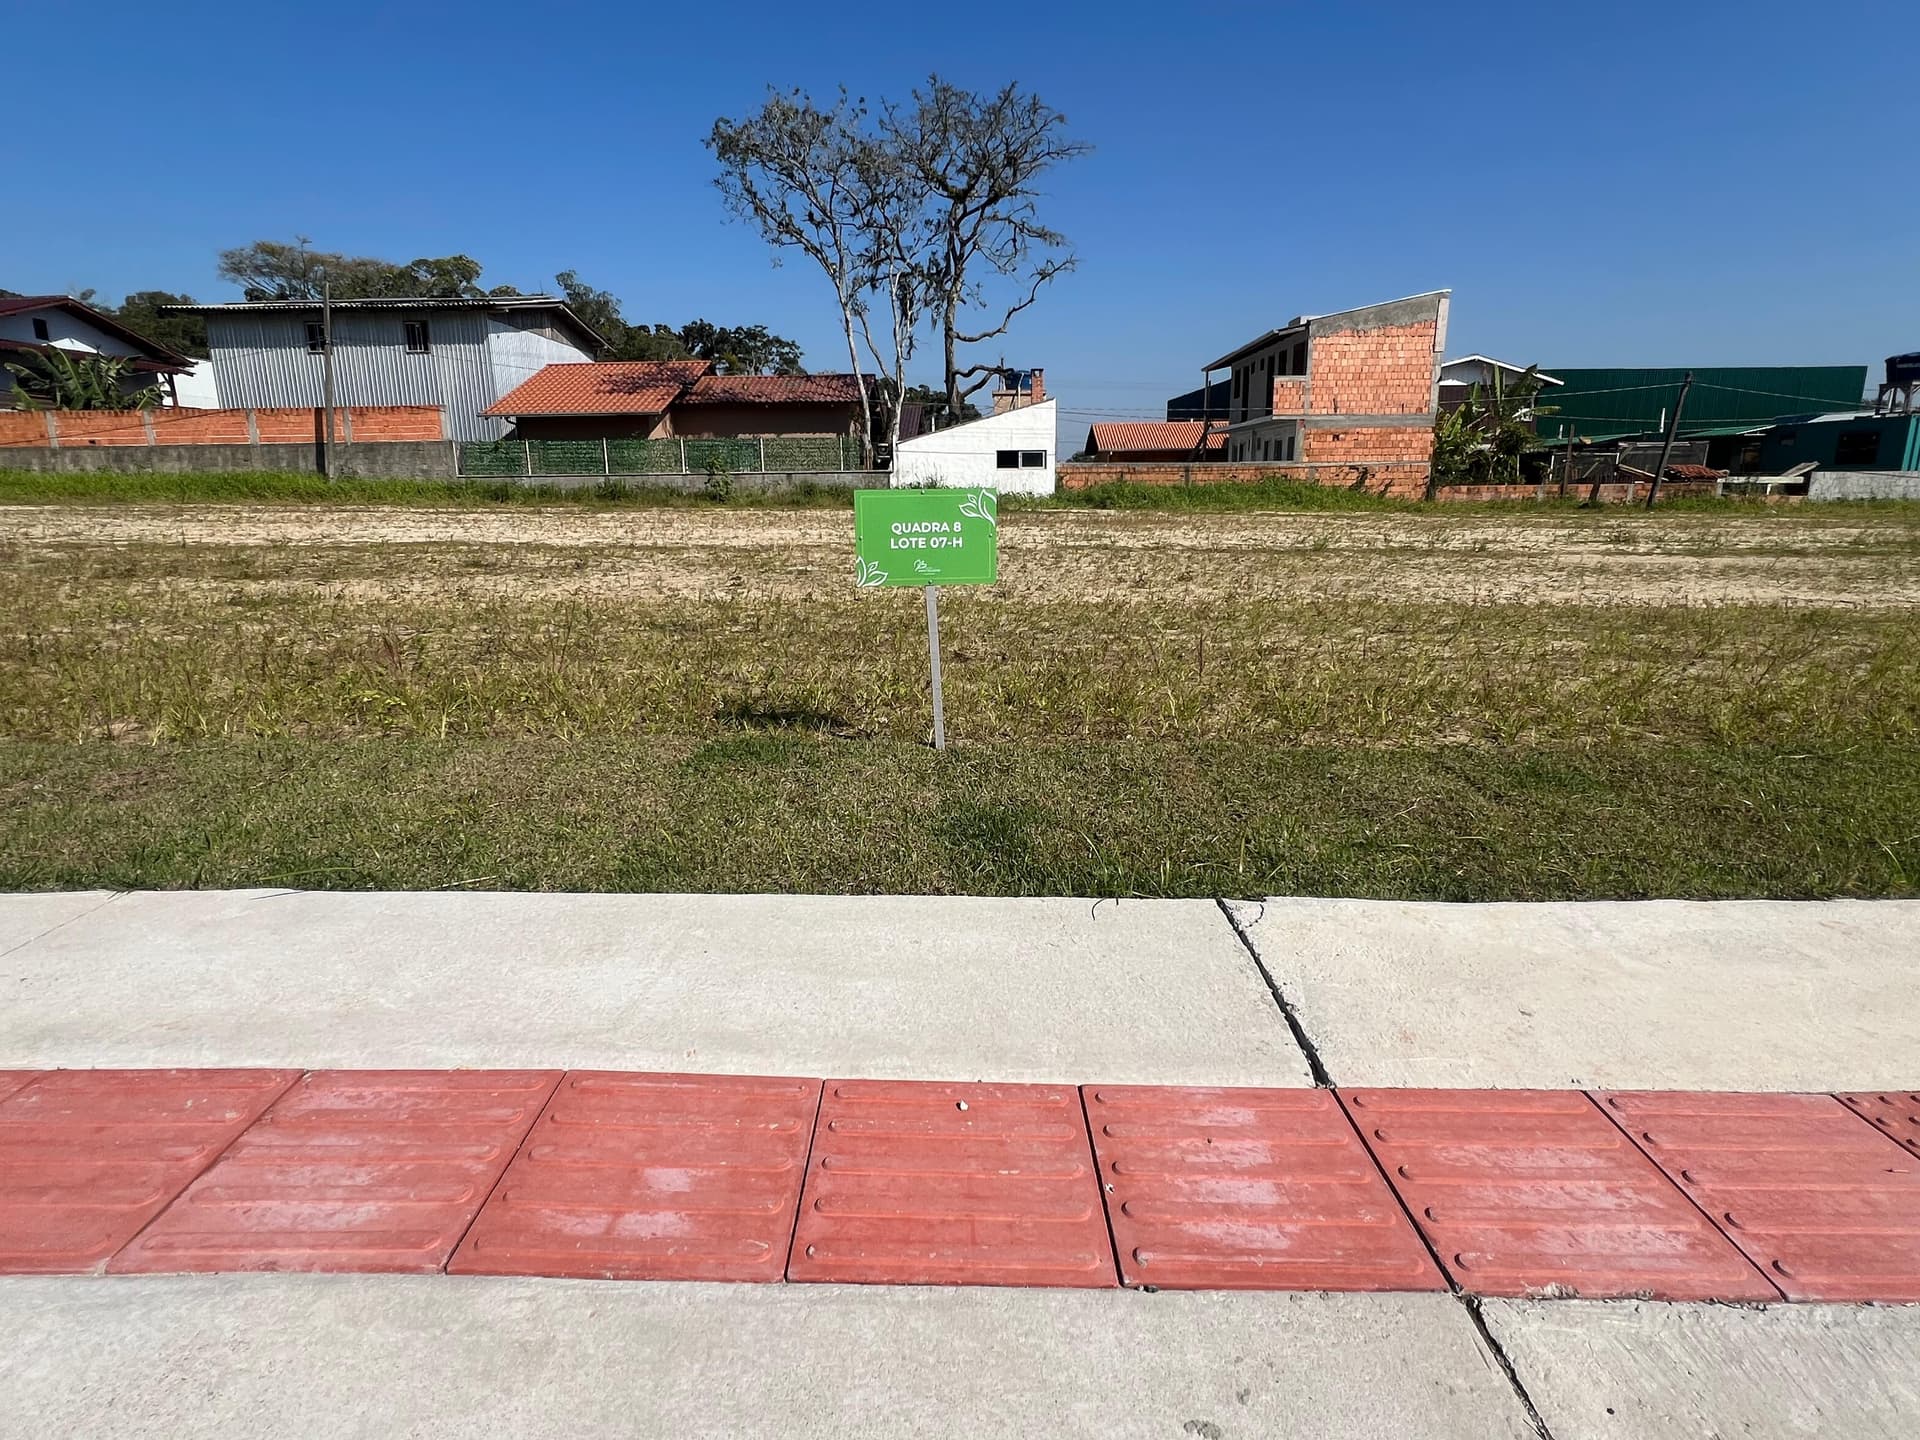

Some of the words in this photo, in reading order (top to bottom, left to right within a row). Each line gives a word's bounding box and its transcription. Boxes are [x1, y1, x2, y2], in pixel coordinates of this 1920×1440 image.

[891, 522, 950, 535] QUADRA
[953, 522, 962, 532] 8
[890, 537, 926, 549] LOTE
[930, 537, 963, 549] 07-H
